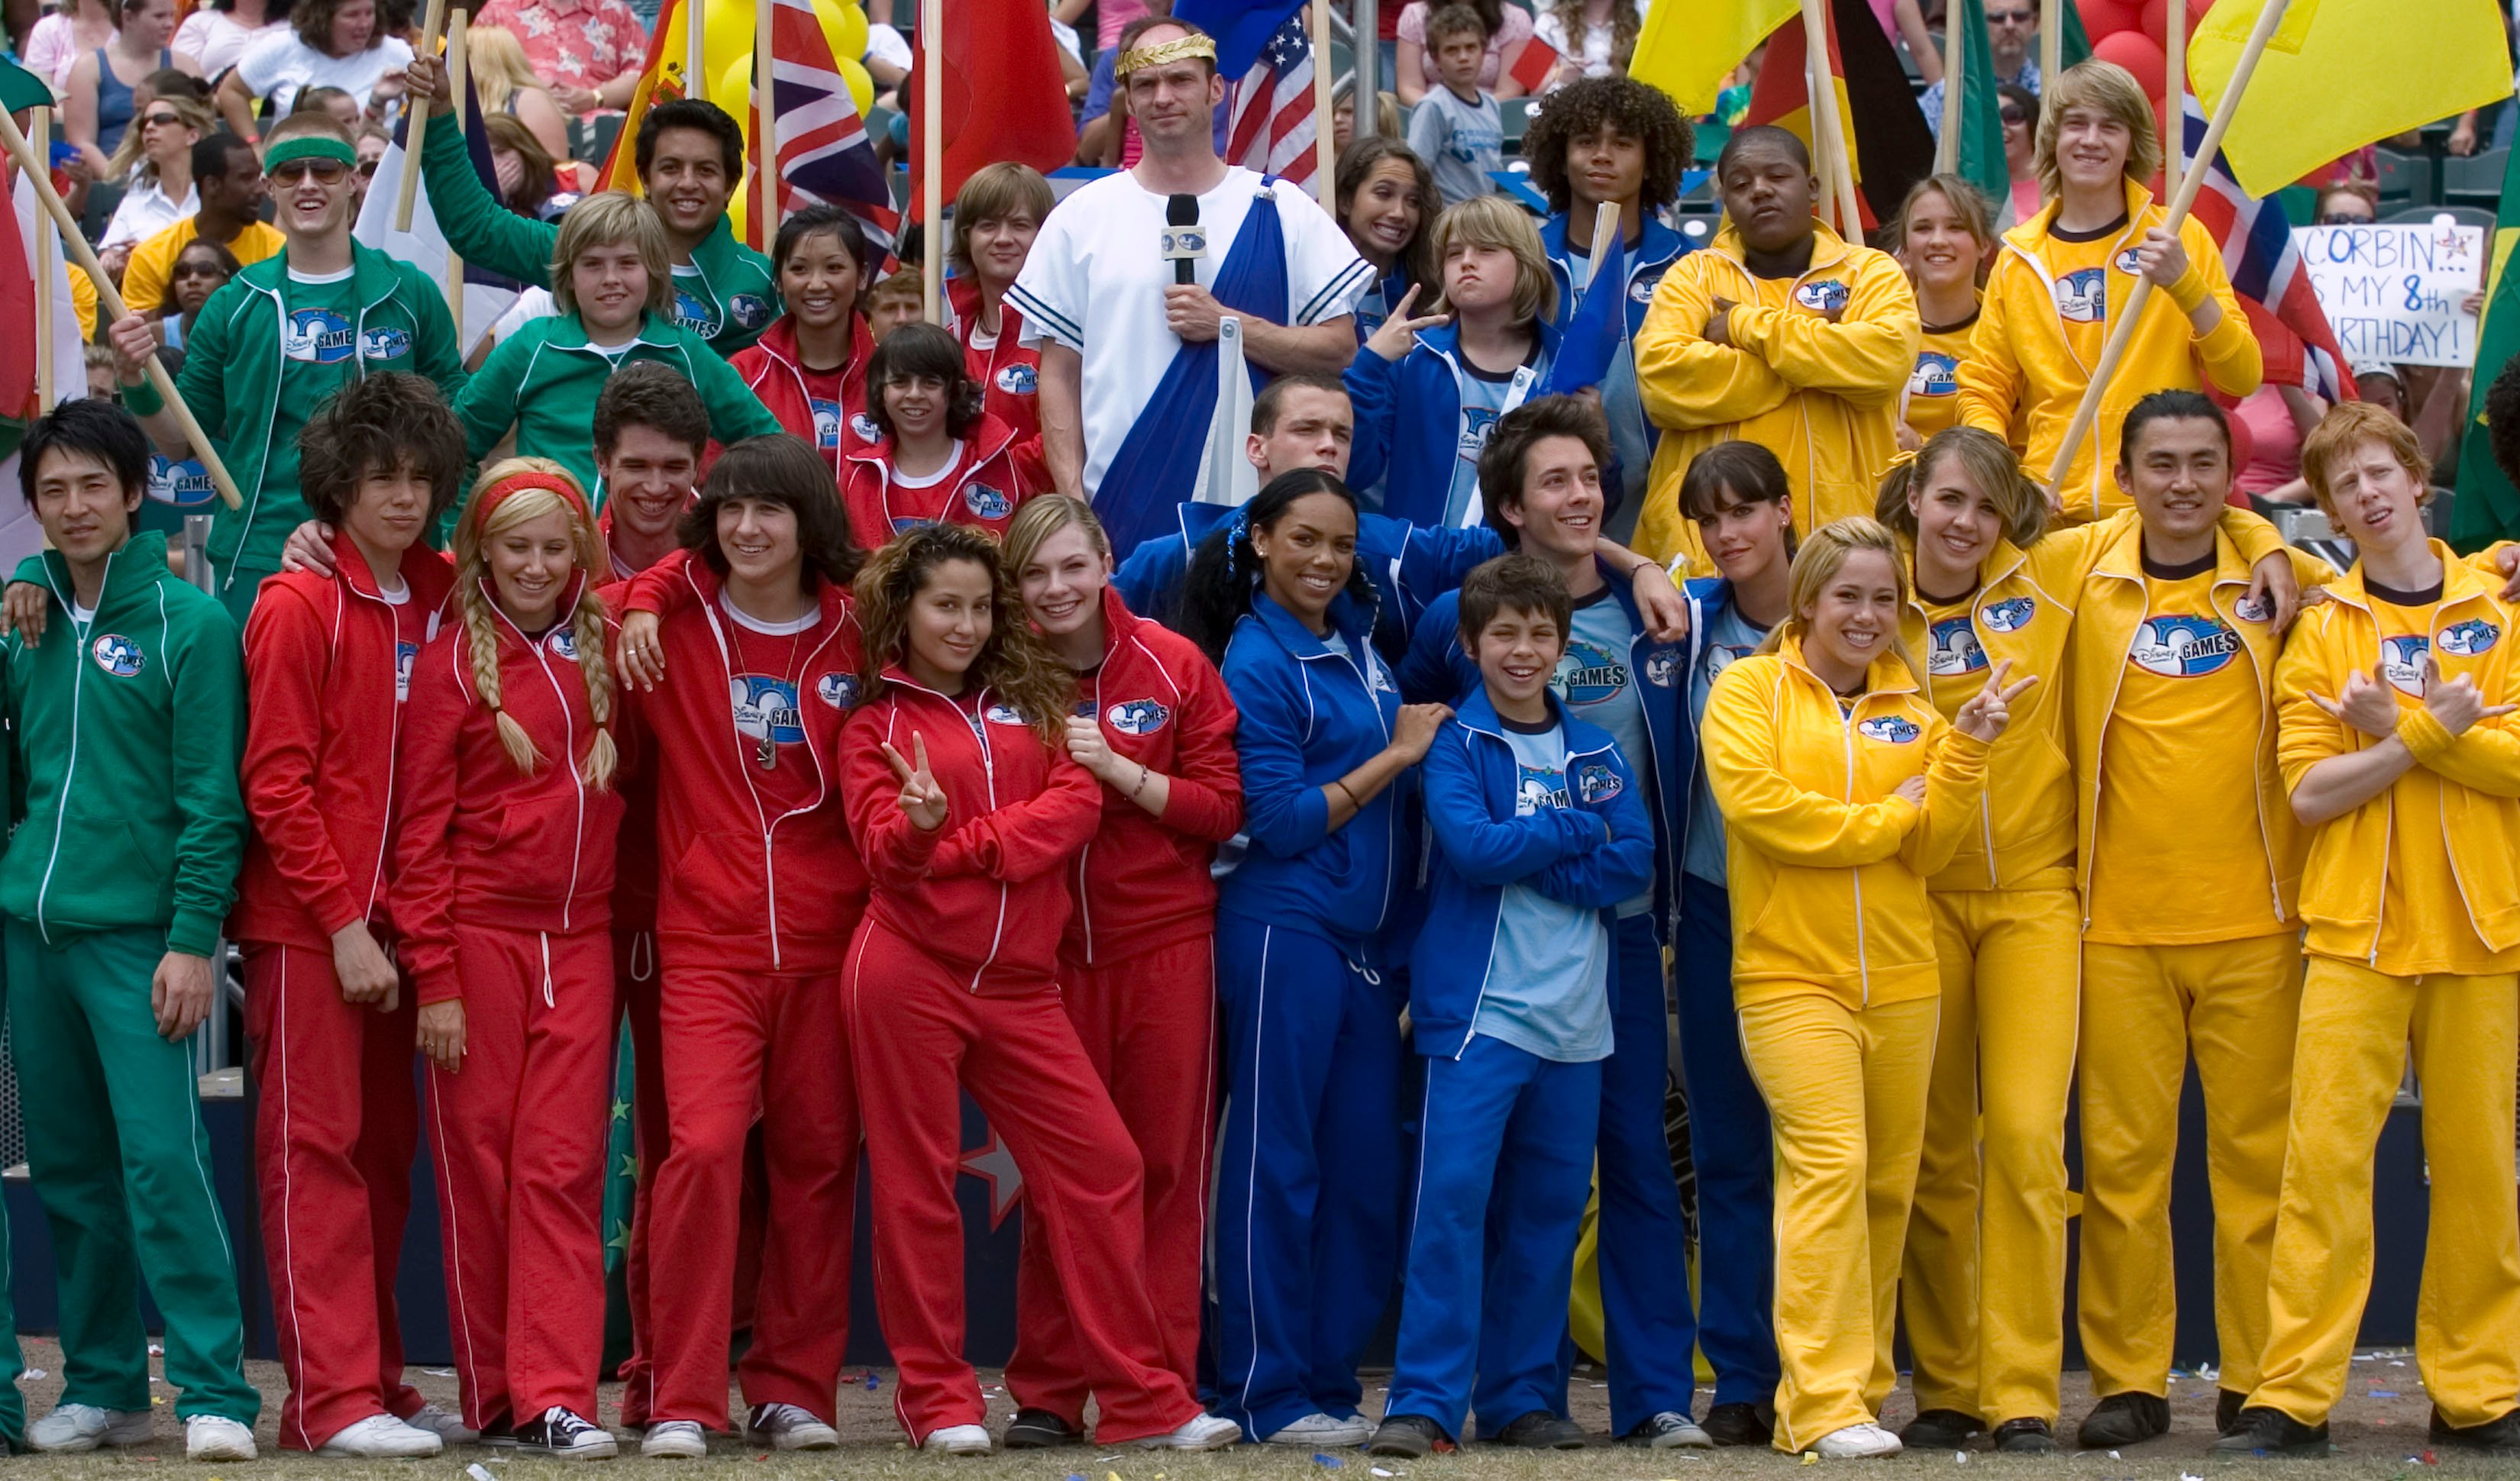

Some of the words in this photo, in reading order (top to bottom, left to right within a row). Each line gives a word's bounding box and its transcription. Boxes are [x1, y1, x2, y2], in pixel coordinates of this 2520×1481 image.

[2341, 276, 2392, 307] MY
[2403, 274, 2449, 315] 8th
[318, 329, 354, 348] GAME
[2332, 316, 2459, 360] RTHDAY!
[1929, 373, 1955, 382] GAM
[176, 475, 217, 492] GAME
[2184, 634, 2239, 658] GAMES
[1571, 666, 1626, 686] GAMES
[771, 708, 800, 726] GAM
